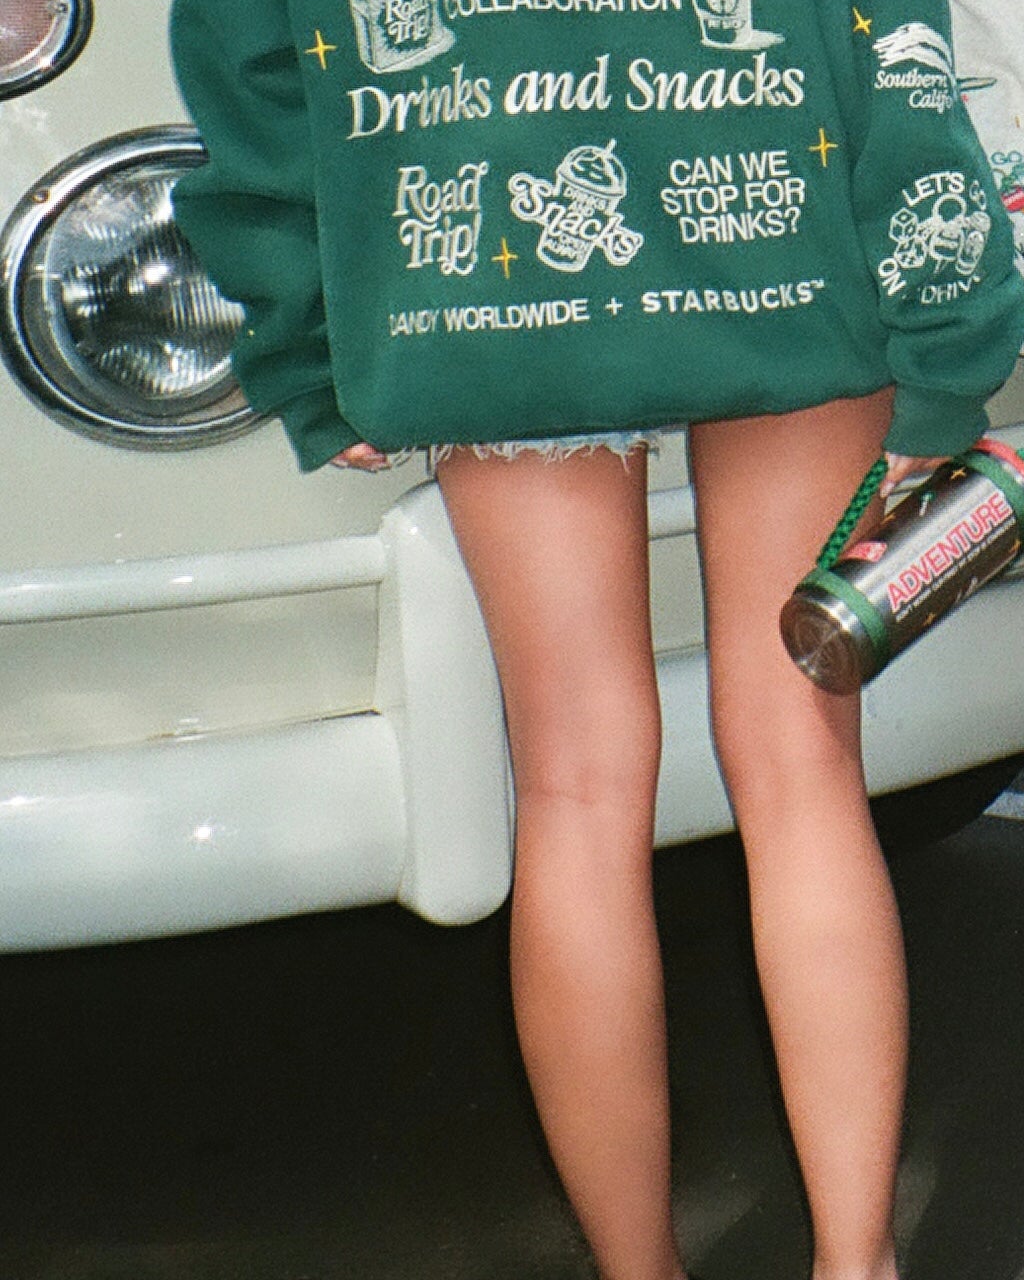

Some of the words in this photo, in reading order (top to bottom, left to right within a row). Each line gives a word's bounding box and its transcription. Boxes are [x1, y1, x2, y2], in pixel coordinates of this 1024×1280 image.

[346, 64, 492, 140] Drinks
[503, 54, 612, 115] and
[625, 52, 805, 112] Snacks
[874, 68, 948, 89] Southern
[669, 154, 733, 186] CAN
[739, 150, 790, 180] WE
[991, 150, 1023, 166] GO
[392, 161, 489, 223] Road
[660, 185, 739, 215] STOP
[745, 178, 806, 210] FOR
[508, 172, 644, 266] Snacks
[679, 206, 801, 243] DRINKS?
[878, 258, 907, 297] ON
[921, 273, 981, 304] DRIV
[443, 299, 590, 333] WORLDWIDE
[886, 489, 1014, 612] ADVENTURE
